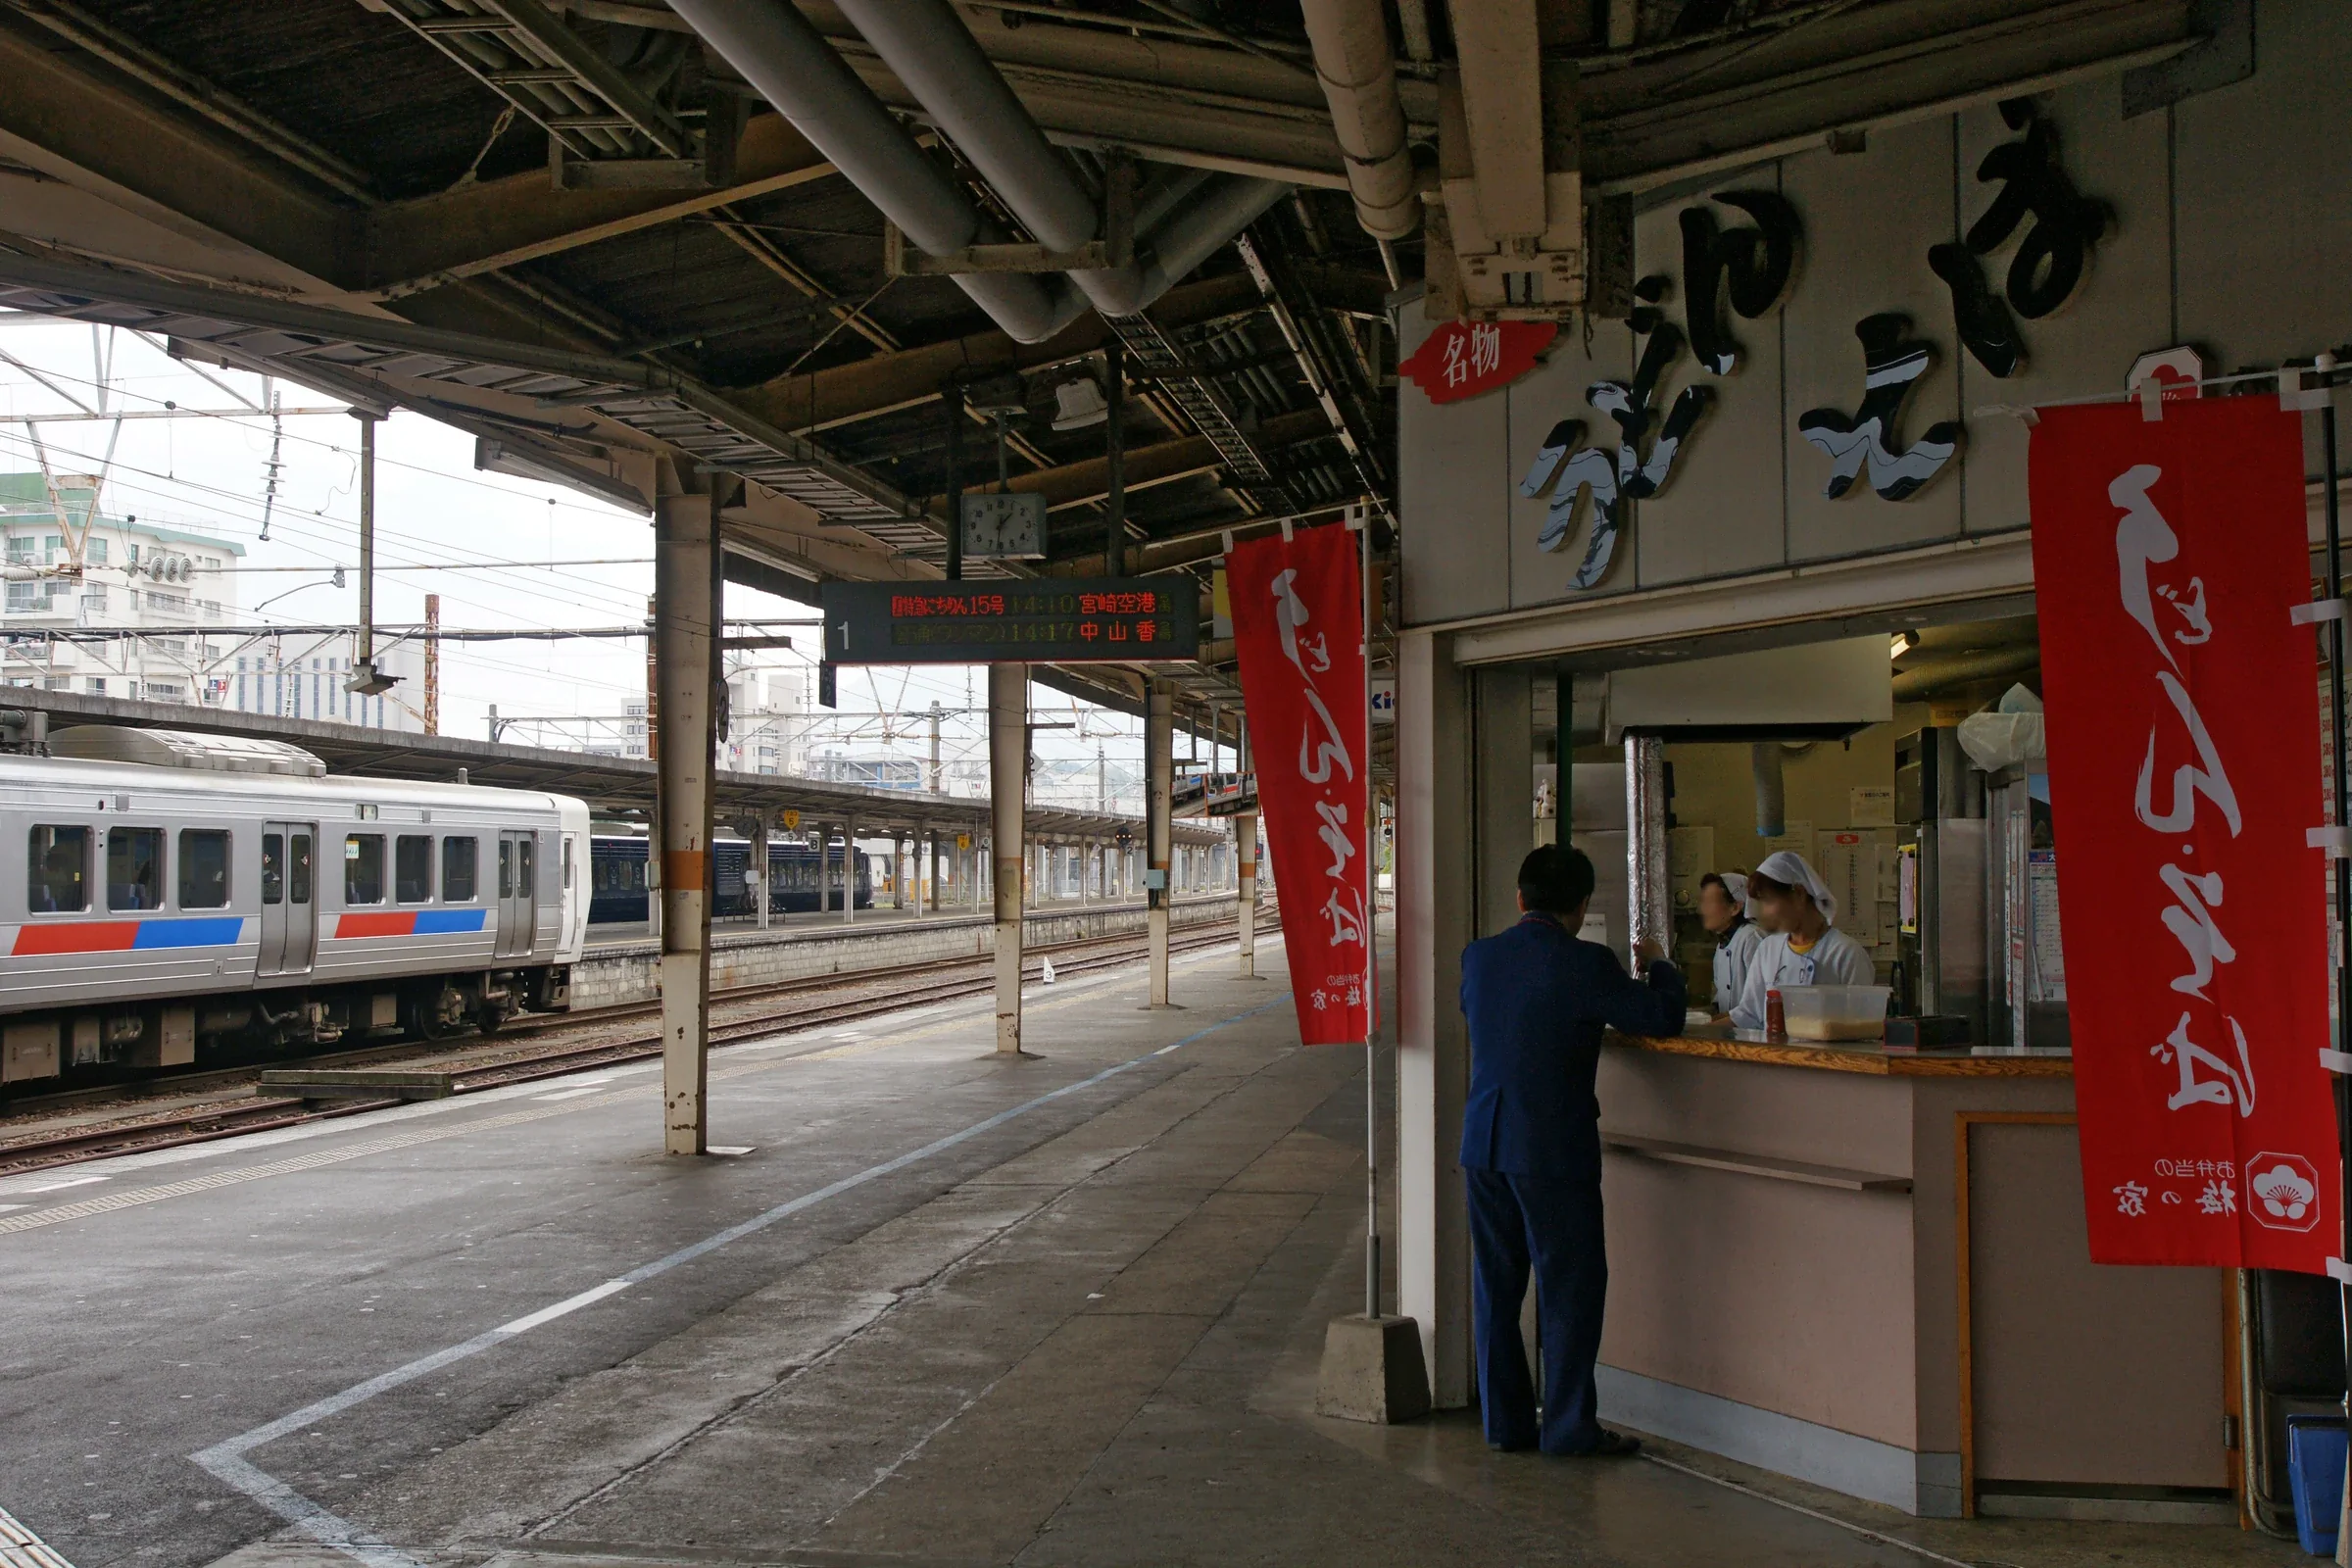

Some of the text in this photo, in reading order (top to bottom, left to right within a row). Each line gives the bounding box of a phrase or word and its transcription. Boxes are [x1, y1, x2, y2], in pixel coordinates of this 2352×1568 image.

[1442, 323, 1500, 388] 名物
[1079, 593, 1155, 614] 宮崎空港
[836, 620, 849, 651] 1
[1011, 622, 1074, 642] 14:17
[1080, 619, 1156, 642] 中山香
[1372, 690, 1396, 710] Ki
[788, 832, 794, 841] 5
[810, 839, 818, 850] B
[1045, 970, 1053, 979] 3
